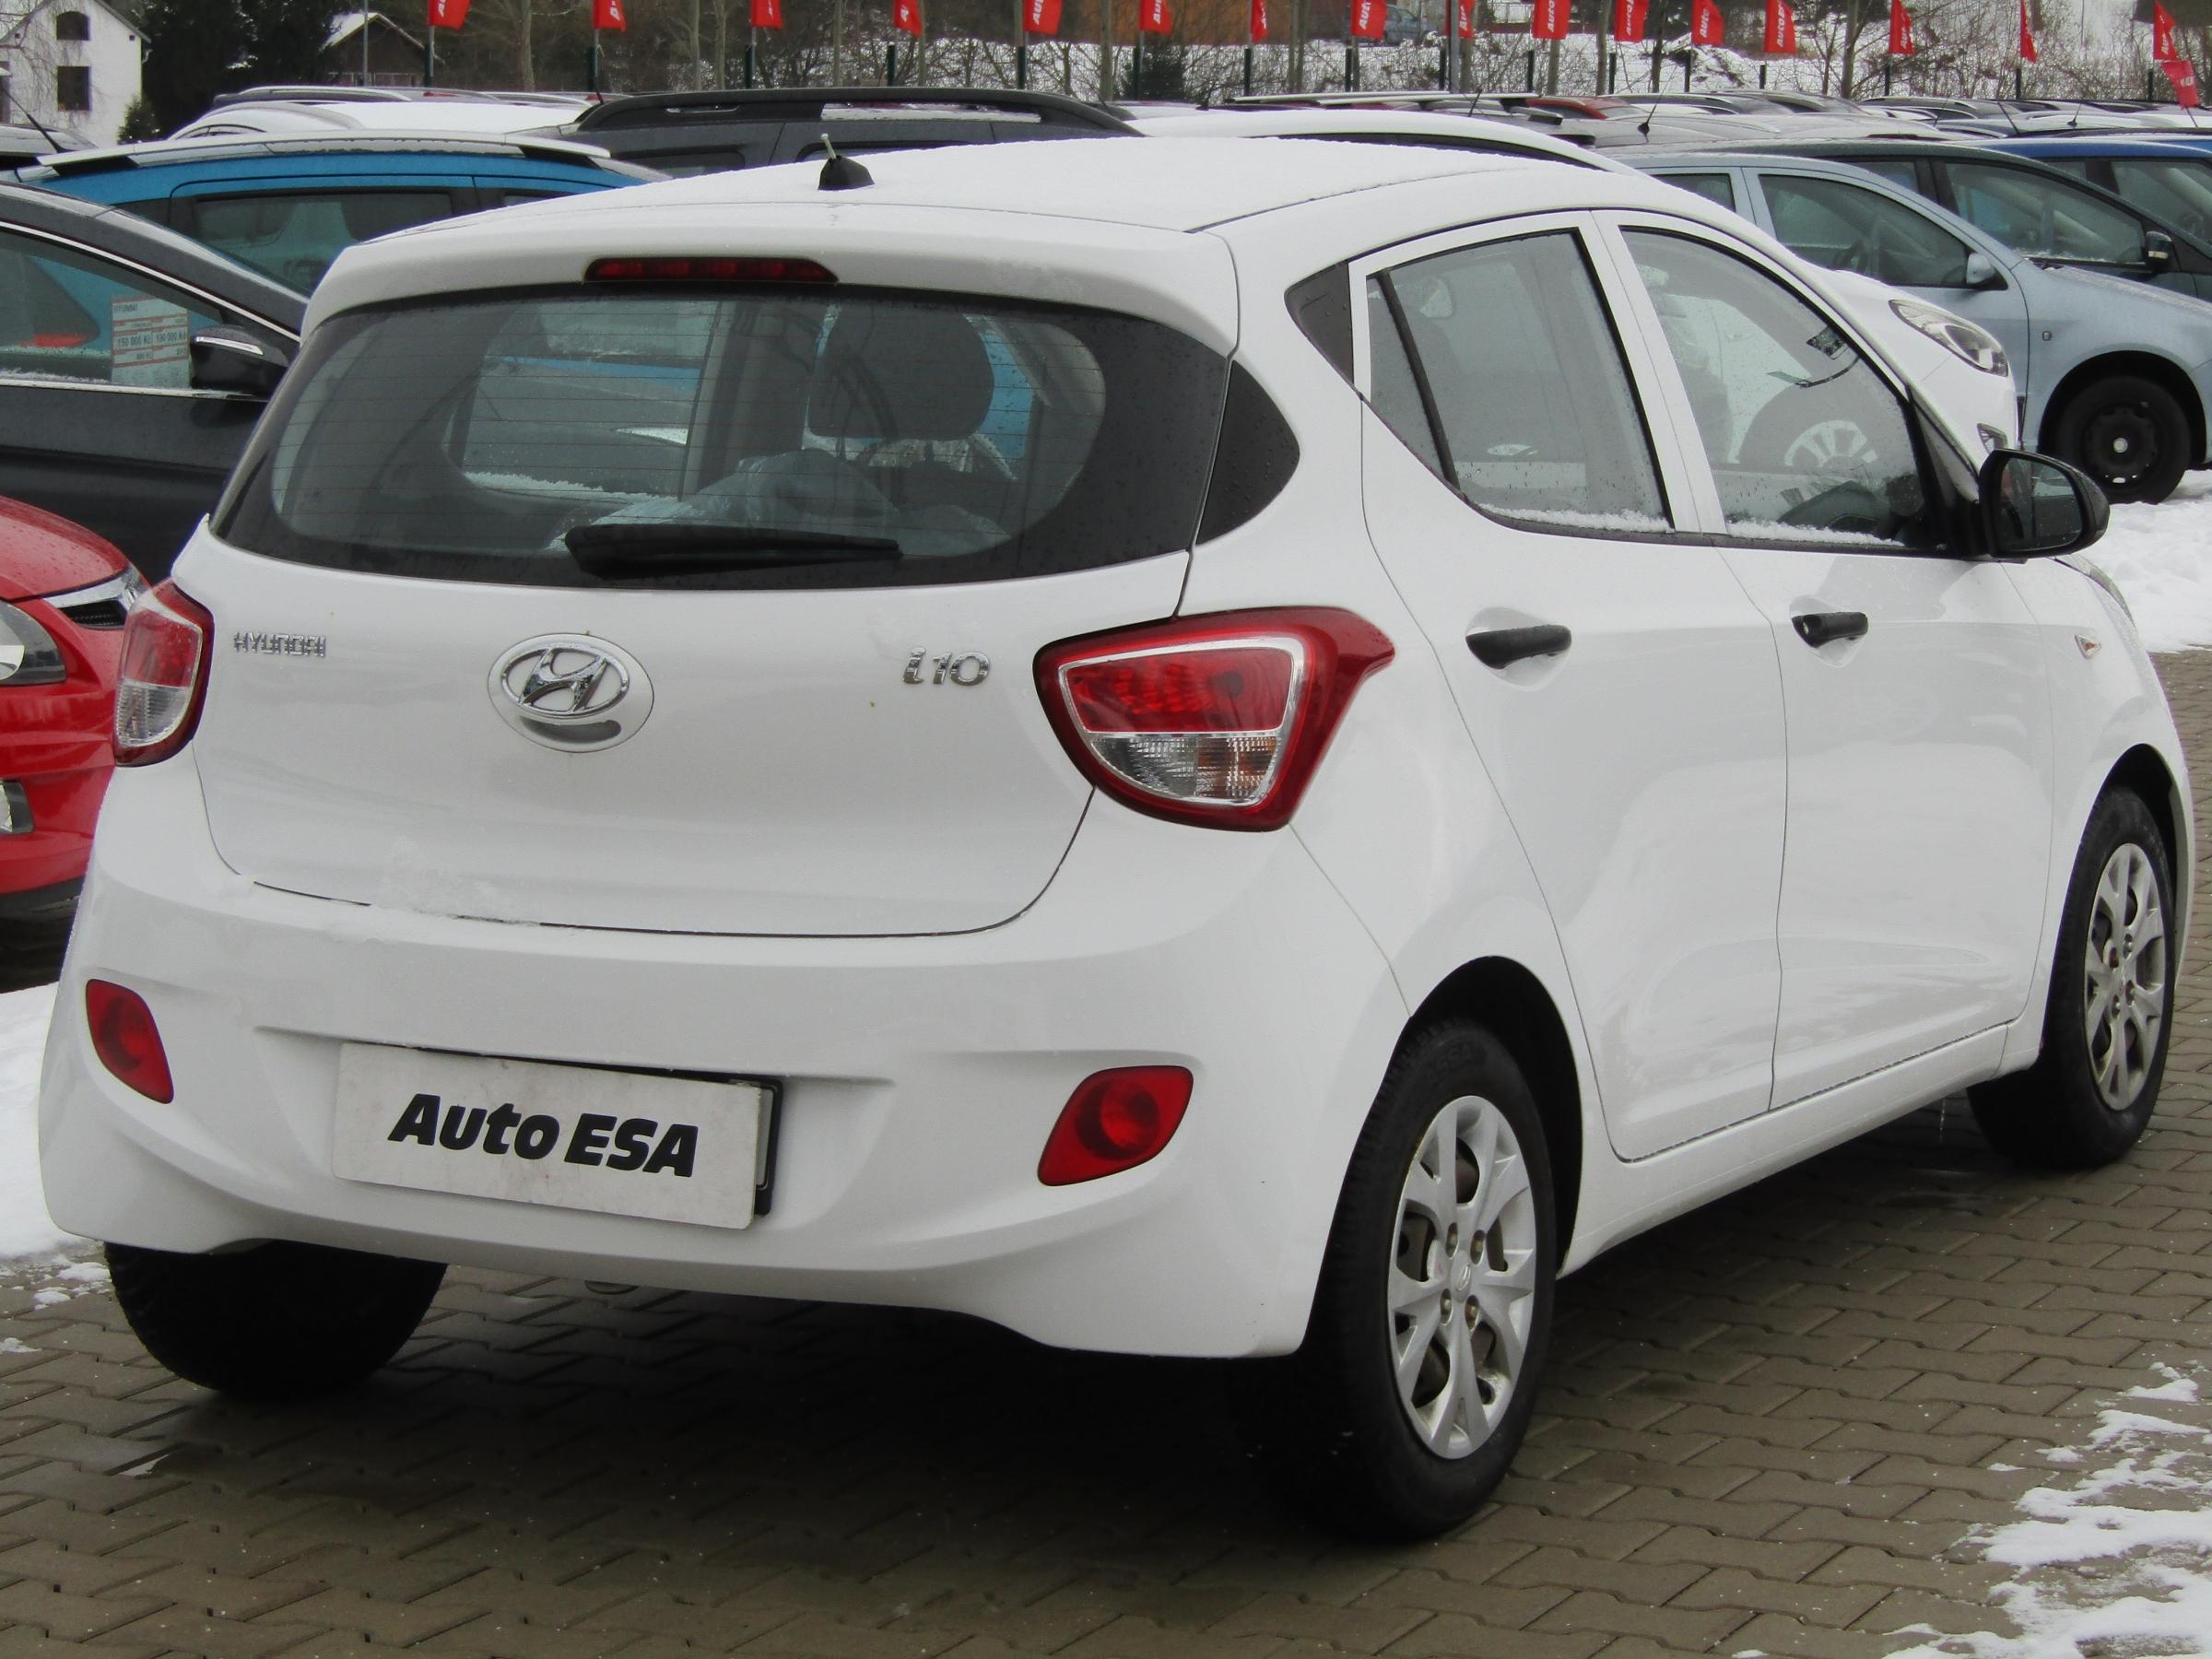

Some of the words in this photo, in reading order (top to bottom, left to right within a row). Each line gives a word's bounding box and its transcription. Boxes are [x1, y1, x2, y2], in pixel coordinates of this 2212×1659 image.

[234, 631, 326, 658] HYUNDAI
[902, 646, 991, 686] i10
[387, 1093, 560, 1160] Auto
[564, 1112, 699, 1178] ESA
